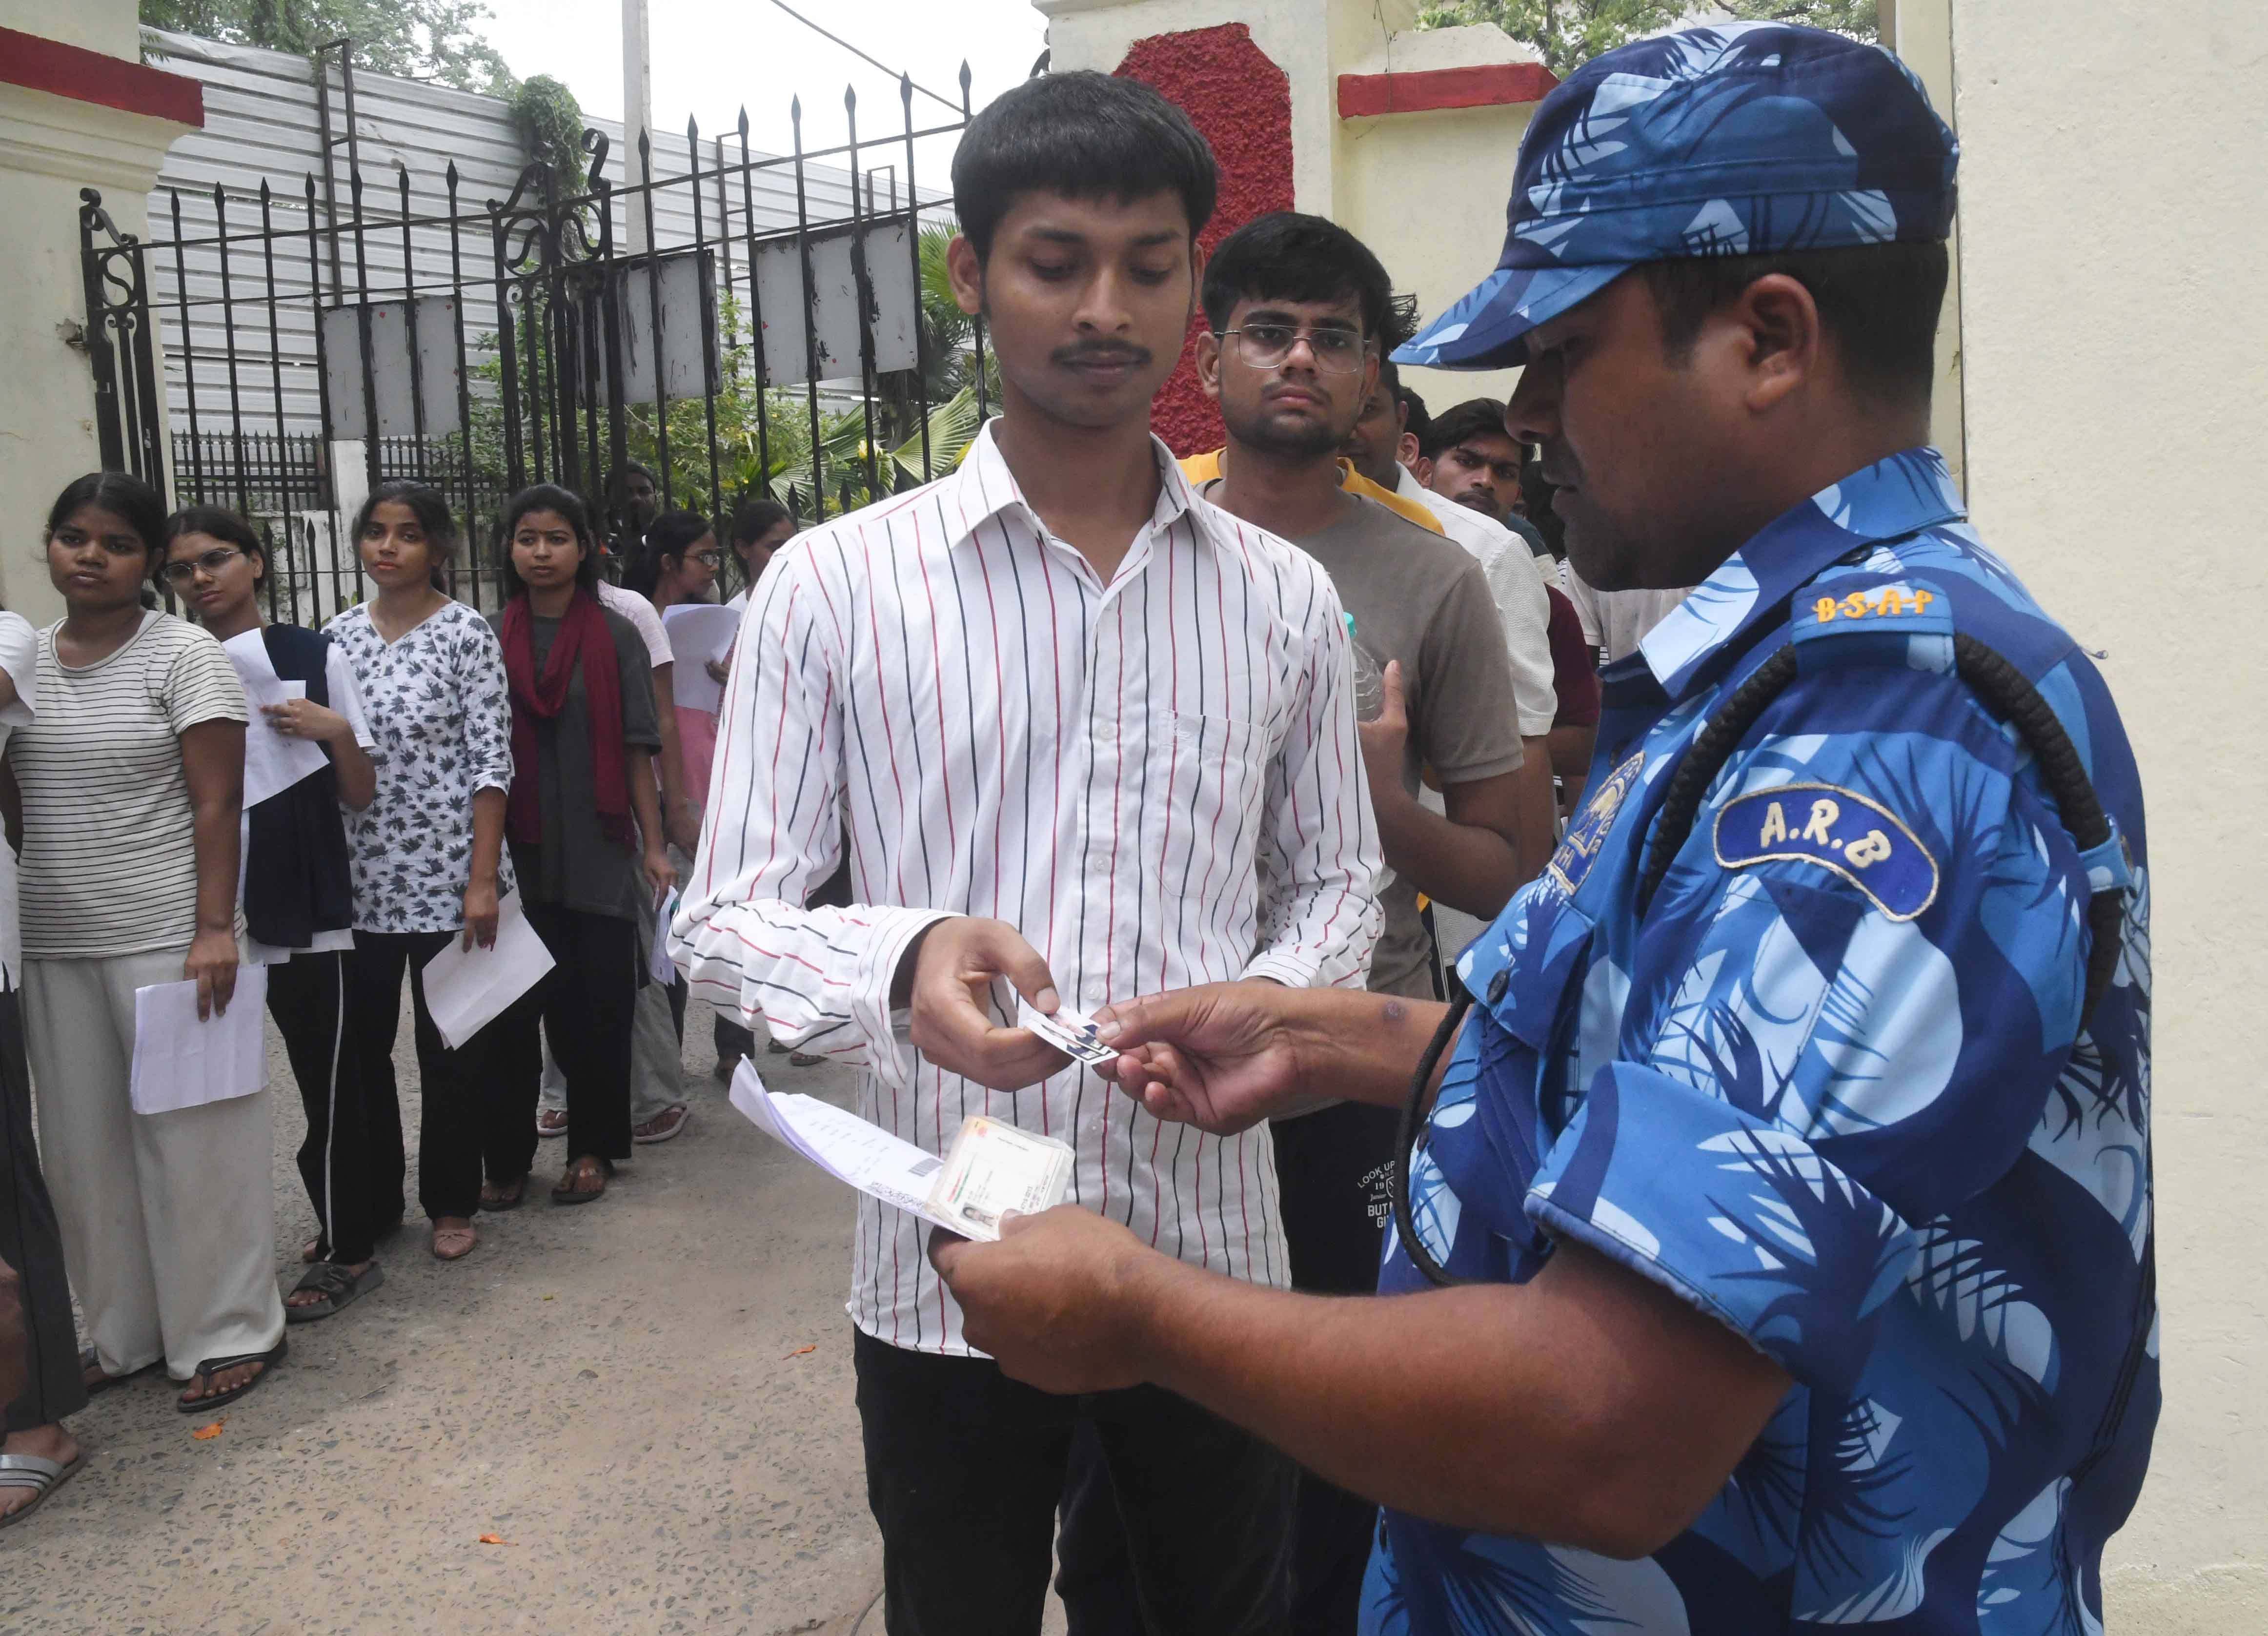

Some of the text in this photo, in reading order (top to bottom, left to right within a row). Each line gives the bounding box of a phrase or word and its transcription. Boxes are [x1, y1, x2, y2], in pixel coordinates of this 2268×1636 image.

[1760, 798, 1892, 868] A.R.B
[1357, 1160, 1395, 1188] LOOK UP
[1368, 1203, 1388, 1216] BUT
